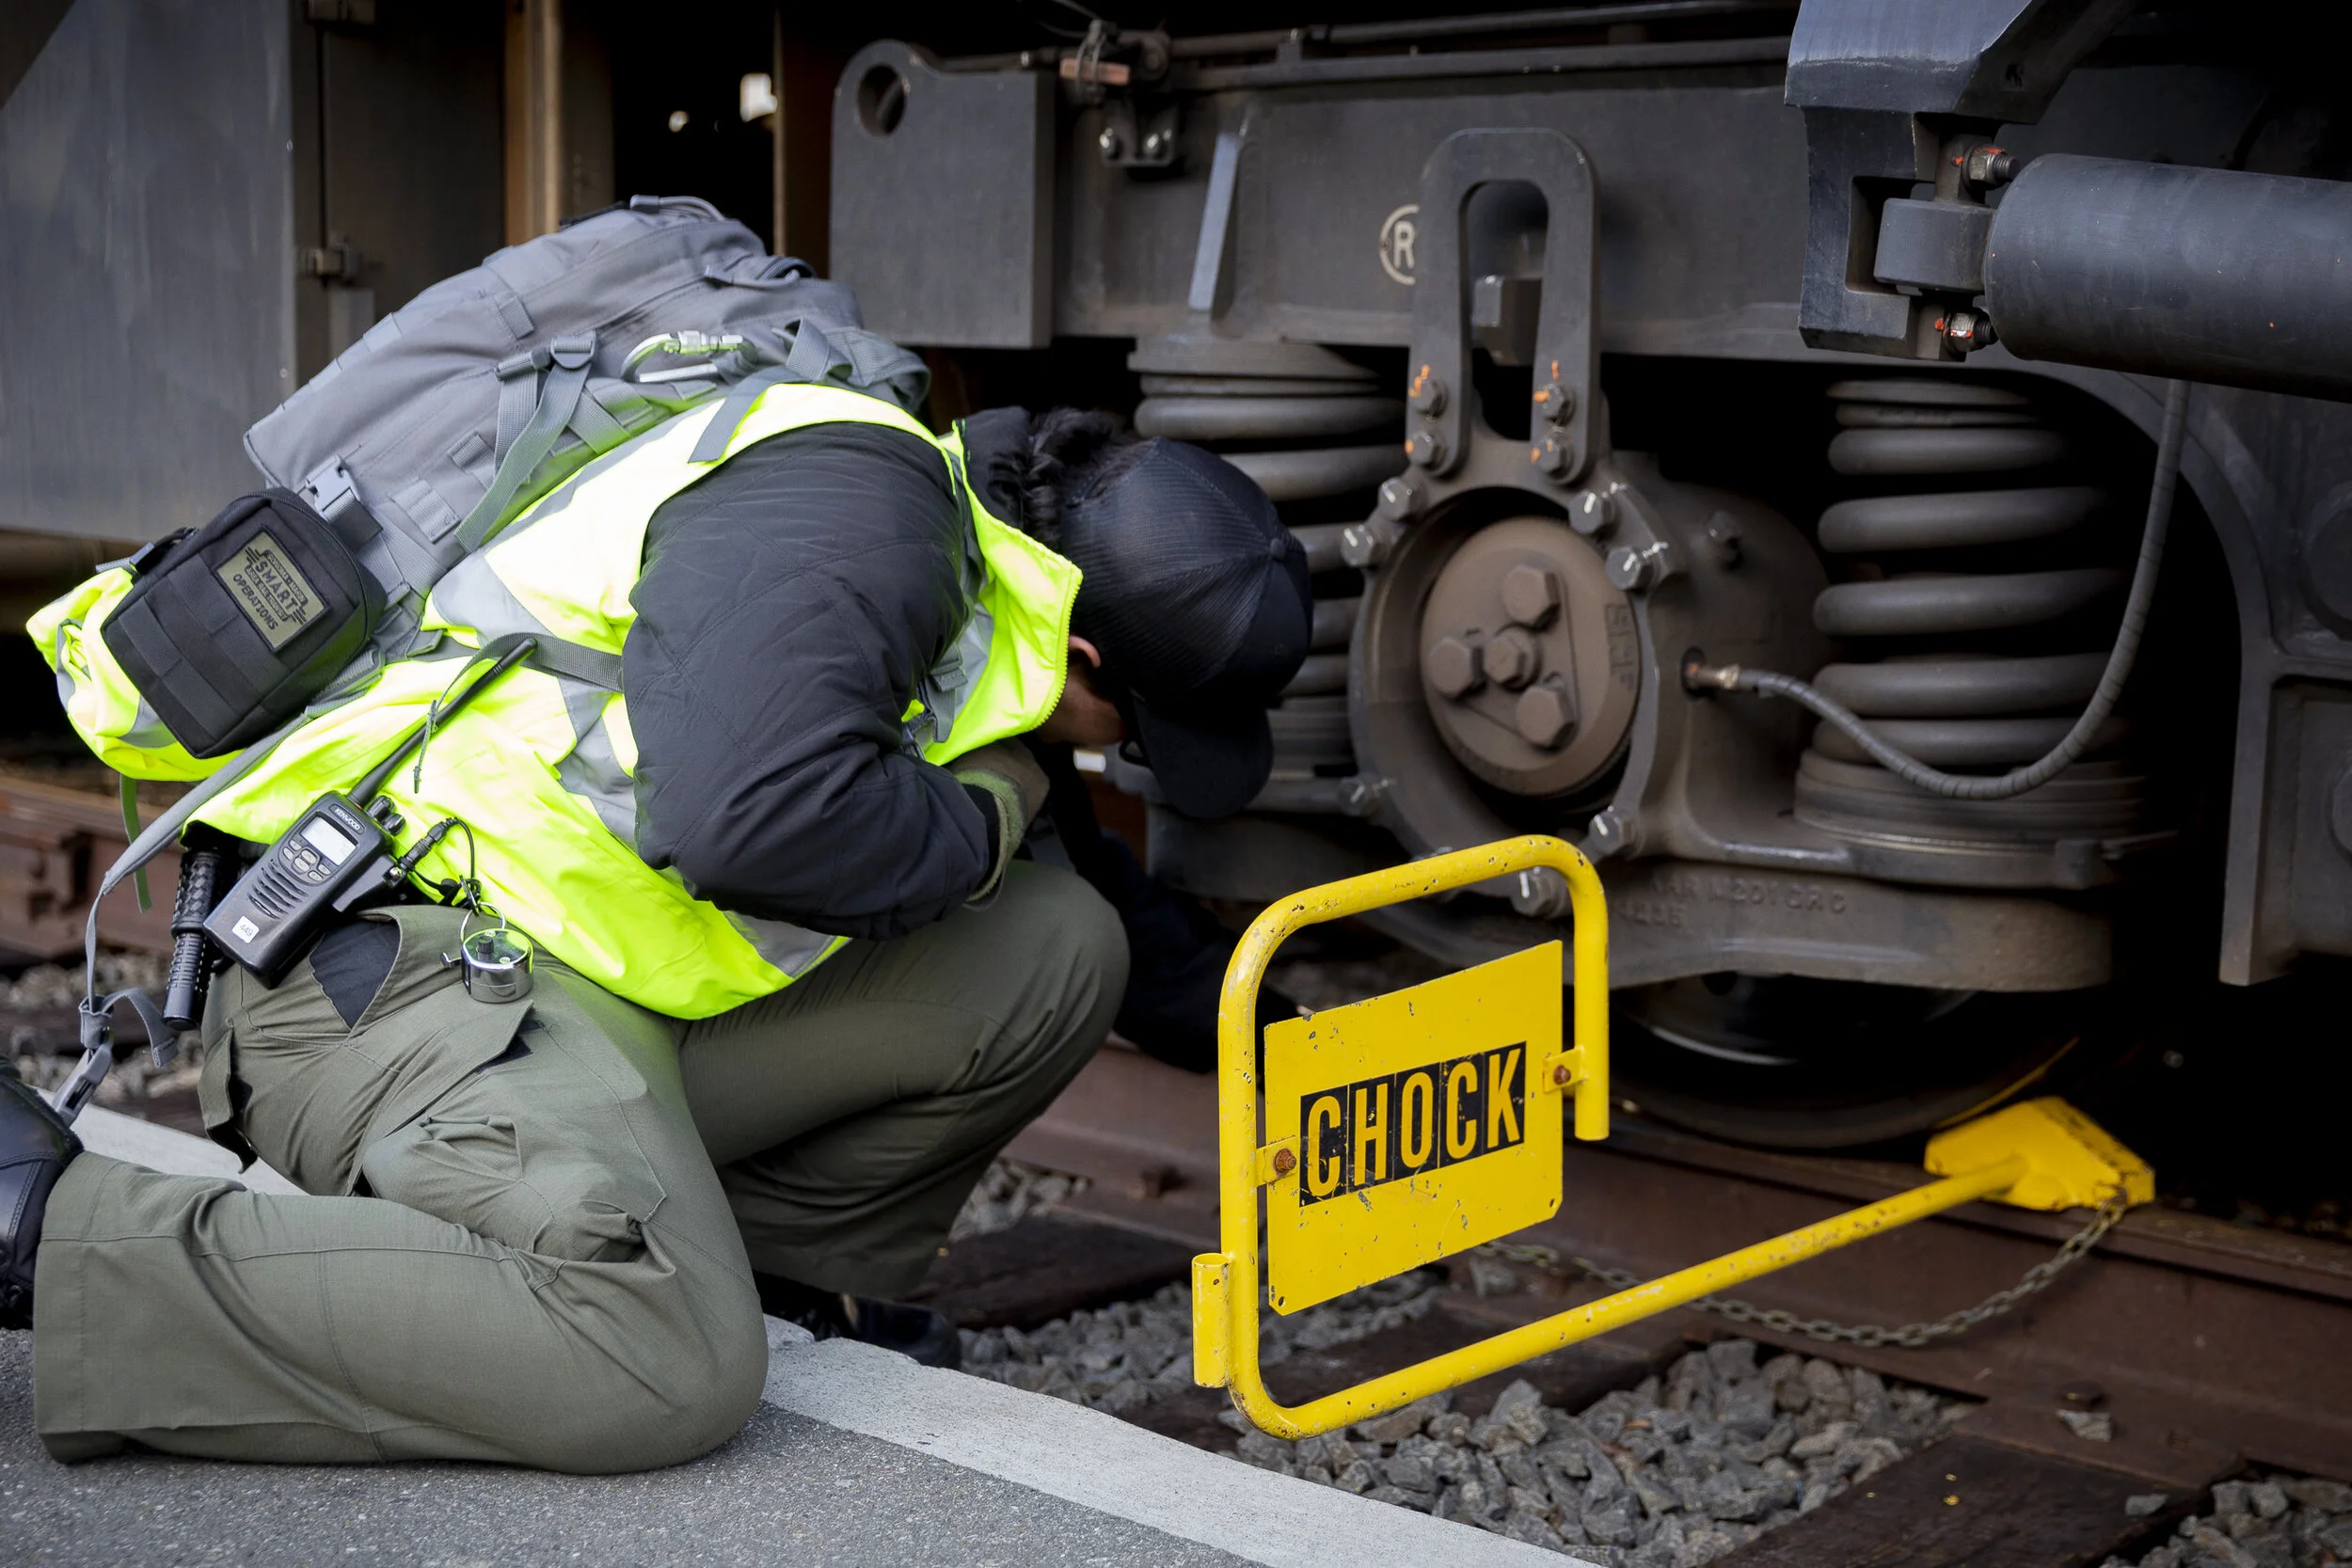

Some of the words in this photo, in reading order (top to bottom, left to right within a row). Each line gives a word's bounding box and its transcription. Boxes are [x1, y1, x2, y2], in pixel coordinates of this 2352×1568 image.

[232, 573, 278, 630] OPERATIONS
[255, 561, 298, 610] SMART
[334, 809, 360, 831] KENWOOD
[1307, 1048, 1521, 1196] CHOCK
